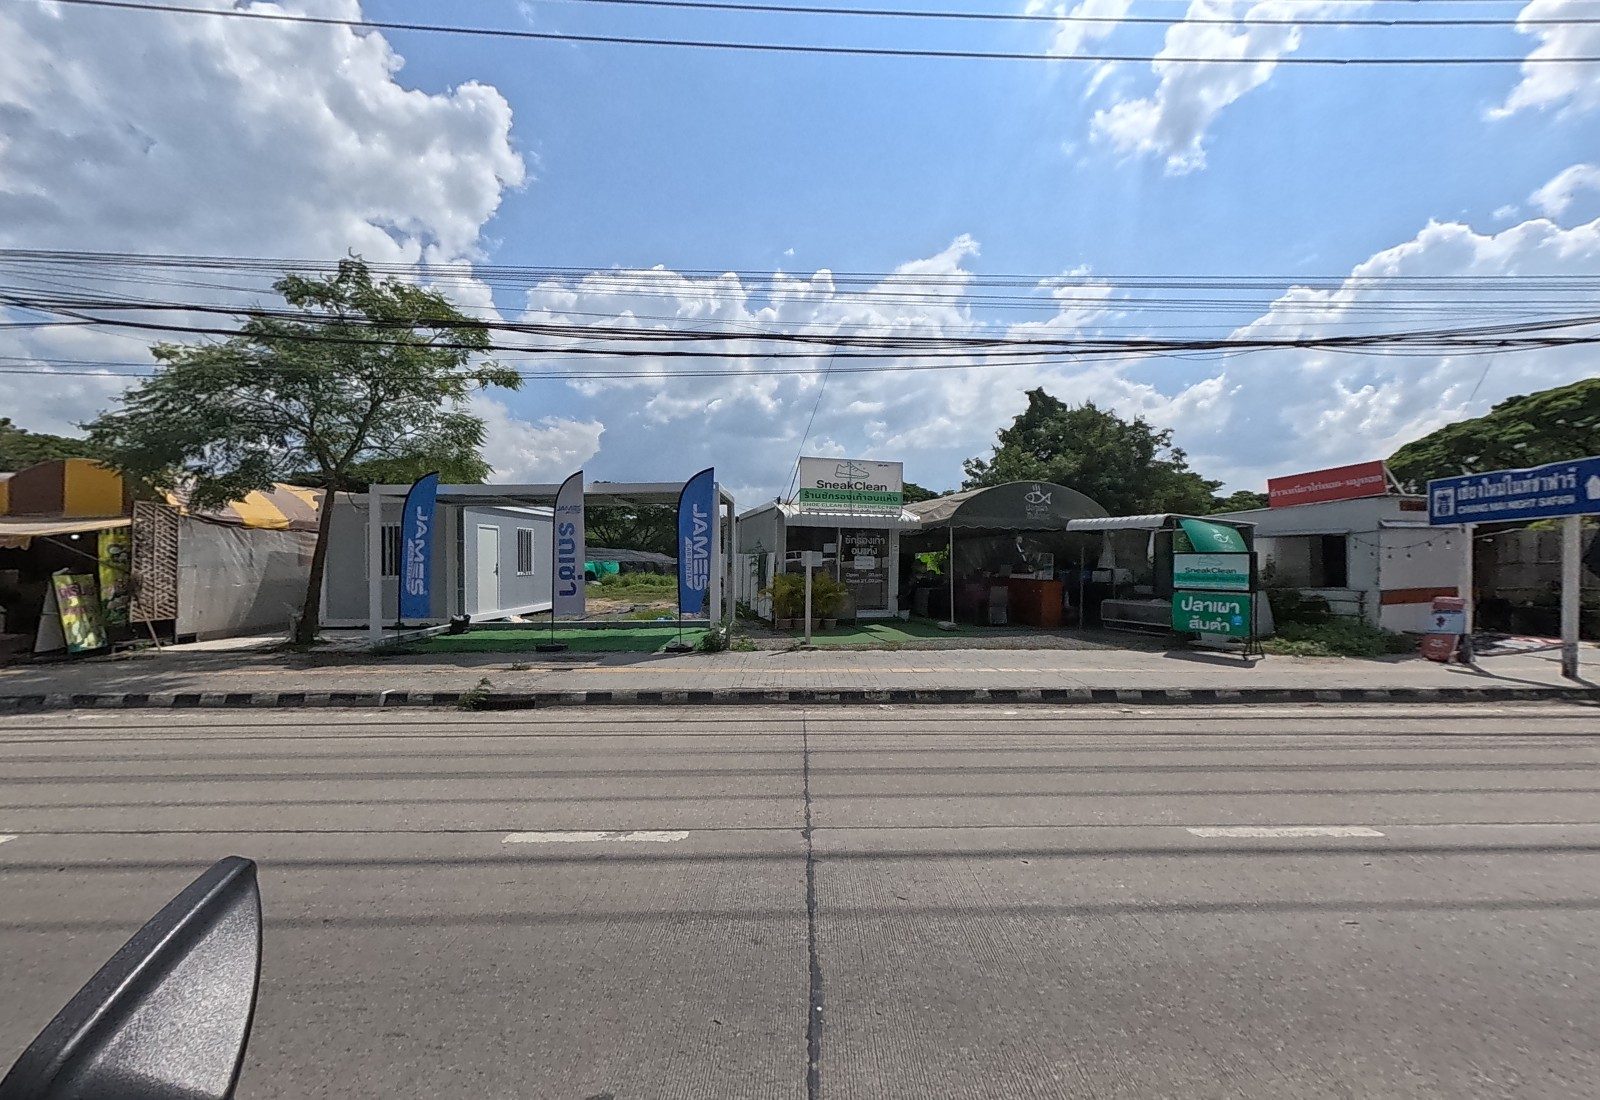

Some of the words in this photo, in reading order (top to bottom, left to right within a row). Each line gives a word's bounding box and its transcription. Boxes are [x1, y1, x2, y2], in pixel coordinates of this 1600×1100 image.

[816, 480, 888, 492] SneakClean
[804, 492, 898, 502] ร้านซักรองเท้าอบแห้ง
[410, 505, 428, 596] JAMES
[692, 503, 709, 591] JAMES
[558, 522, 583, 597] รถเช่า
[1181, 596, 1240, 614] ปลาเผา
[1189, 615, 1230, 632] ส้มตำ
